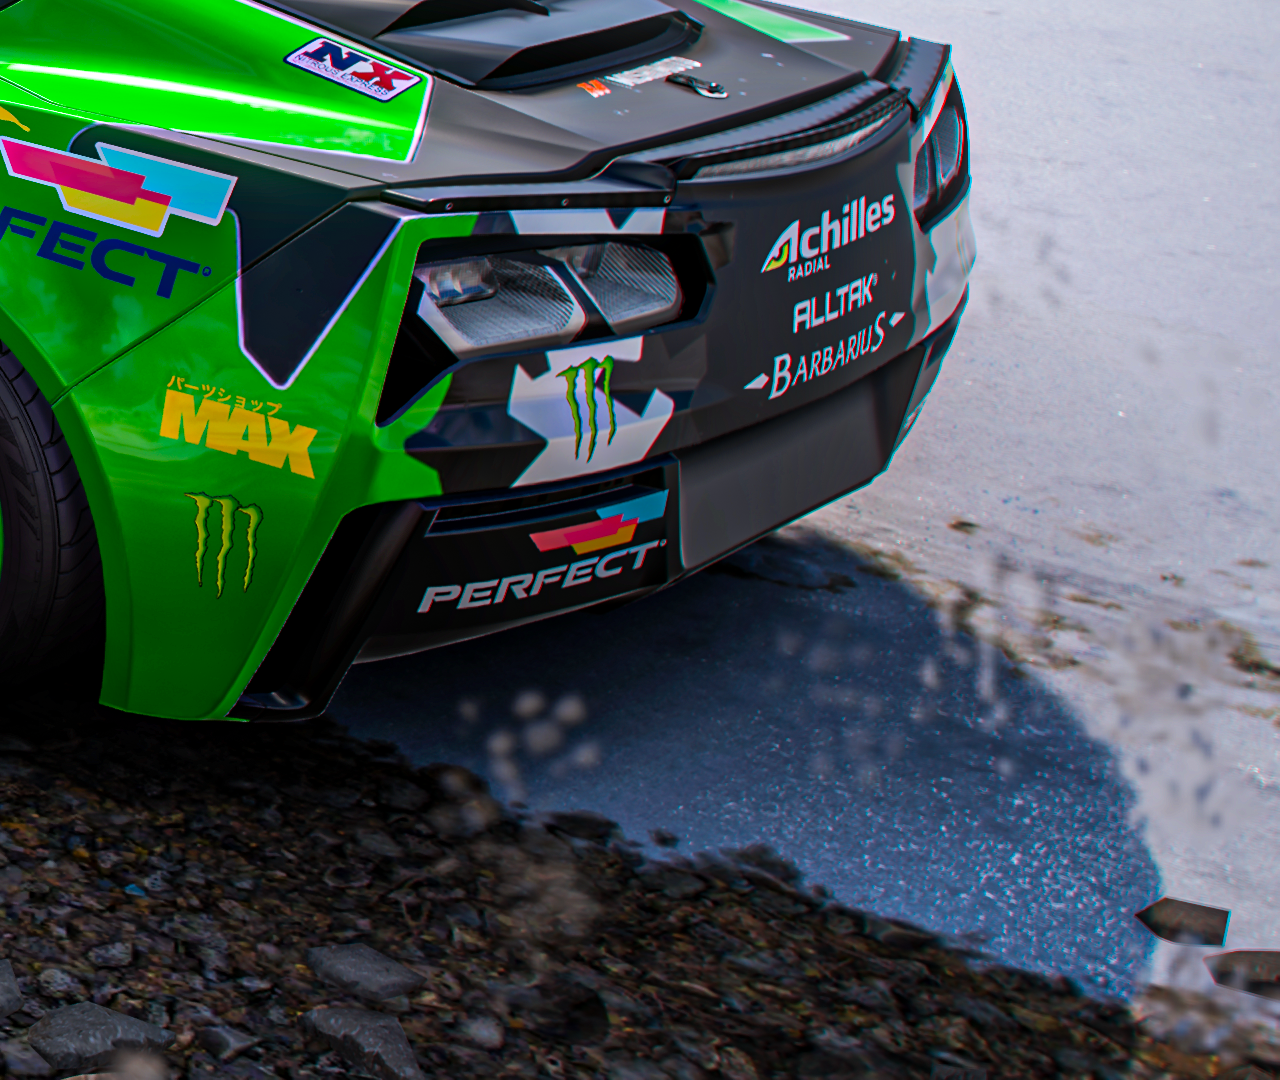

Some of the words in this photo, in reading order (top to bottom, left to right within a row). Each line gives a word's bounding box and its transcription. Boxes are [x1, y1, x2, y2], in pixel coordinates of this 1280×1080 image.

[294, 53, 340, 76] NITROUS
[301, 40, 414, 92] NX
[761, 193, 896, 274] Achilles
[787, 254, 832, 283] RADIAL
[166, 375, 283, 416] パーツショップ
[159, 388, 318, 479] MAX
